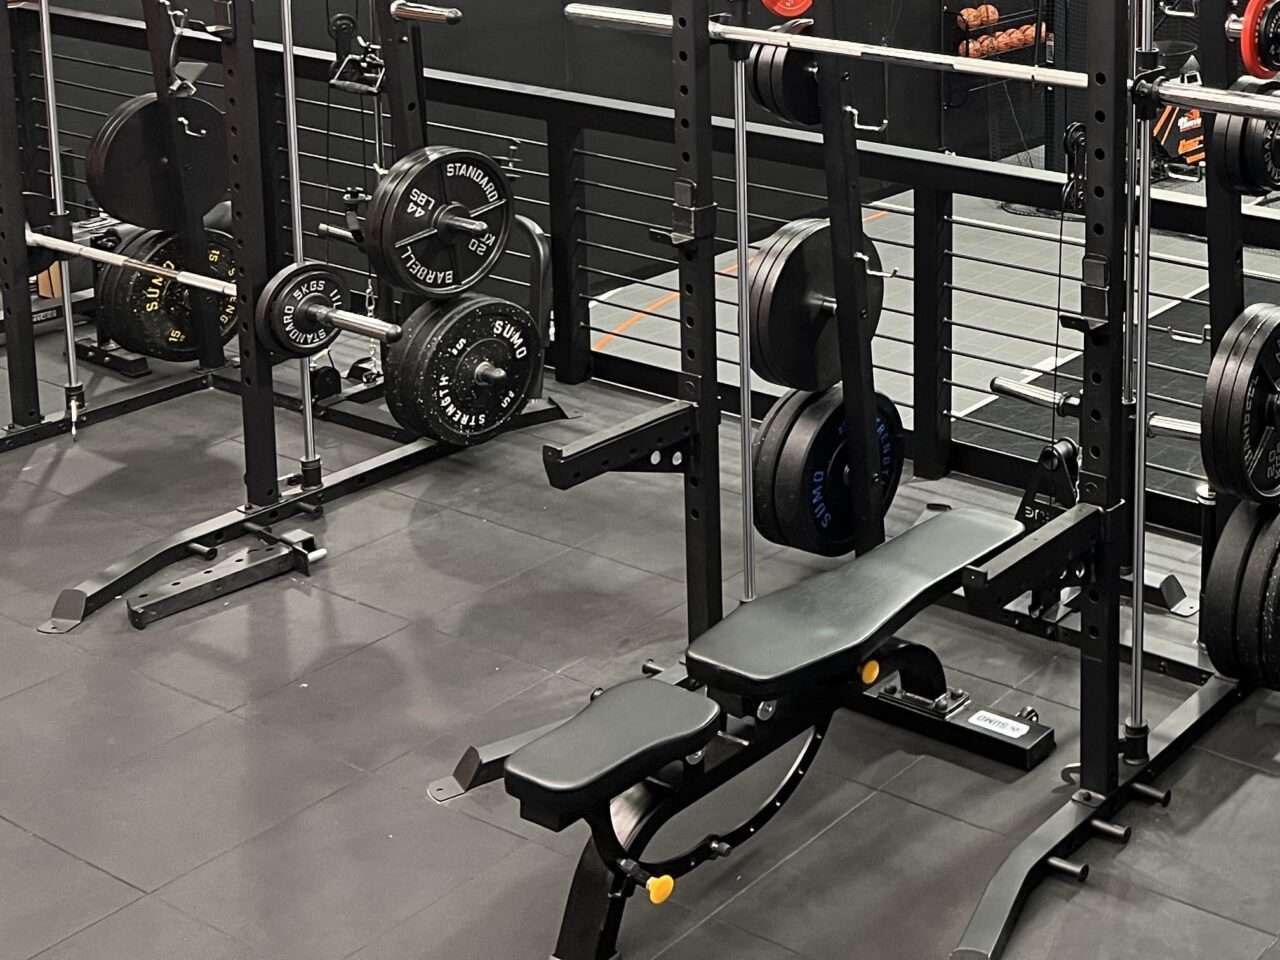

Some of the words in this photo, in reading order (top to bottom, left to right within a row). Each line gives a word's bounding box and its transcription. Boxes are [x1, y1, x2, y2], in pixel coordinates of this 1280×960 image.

[409, 188, 435, 210] LBS
[446, 162, 499, 202] STANDARD
[406, 201, 425, 218] 44
[401, 246, 453, 284] BARBELL
[468, 238, 487, 256] 20
[293, 280, 326, 301] 5KGS
[283, 305, 327, 344] STANDARD
[494, 320, 528, 359] SUMO
[438, 375, 486, 426] STRENGTH
[812, 471, 832, 528] SUMO
